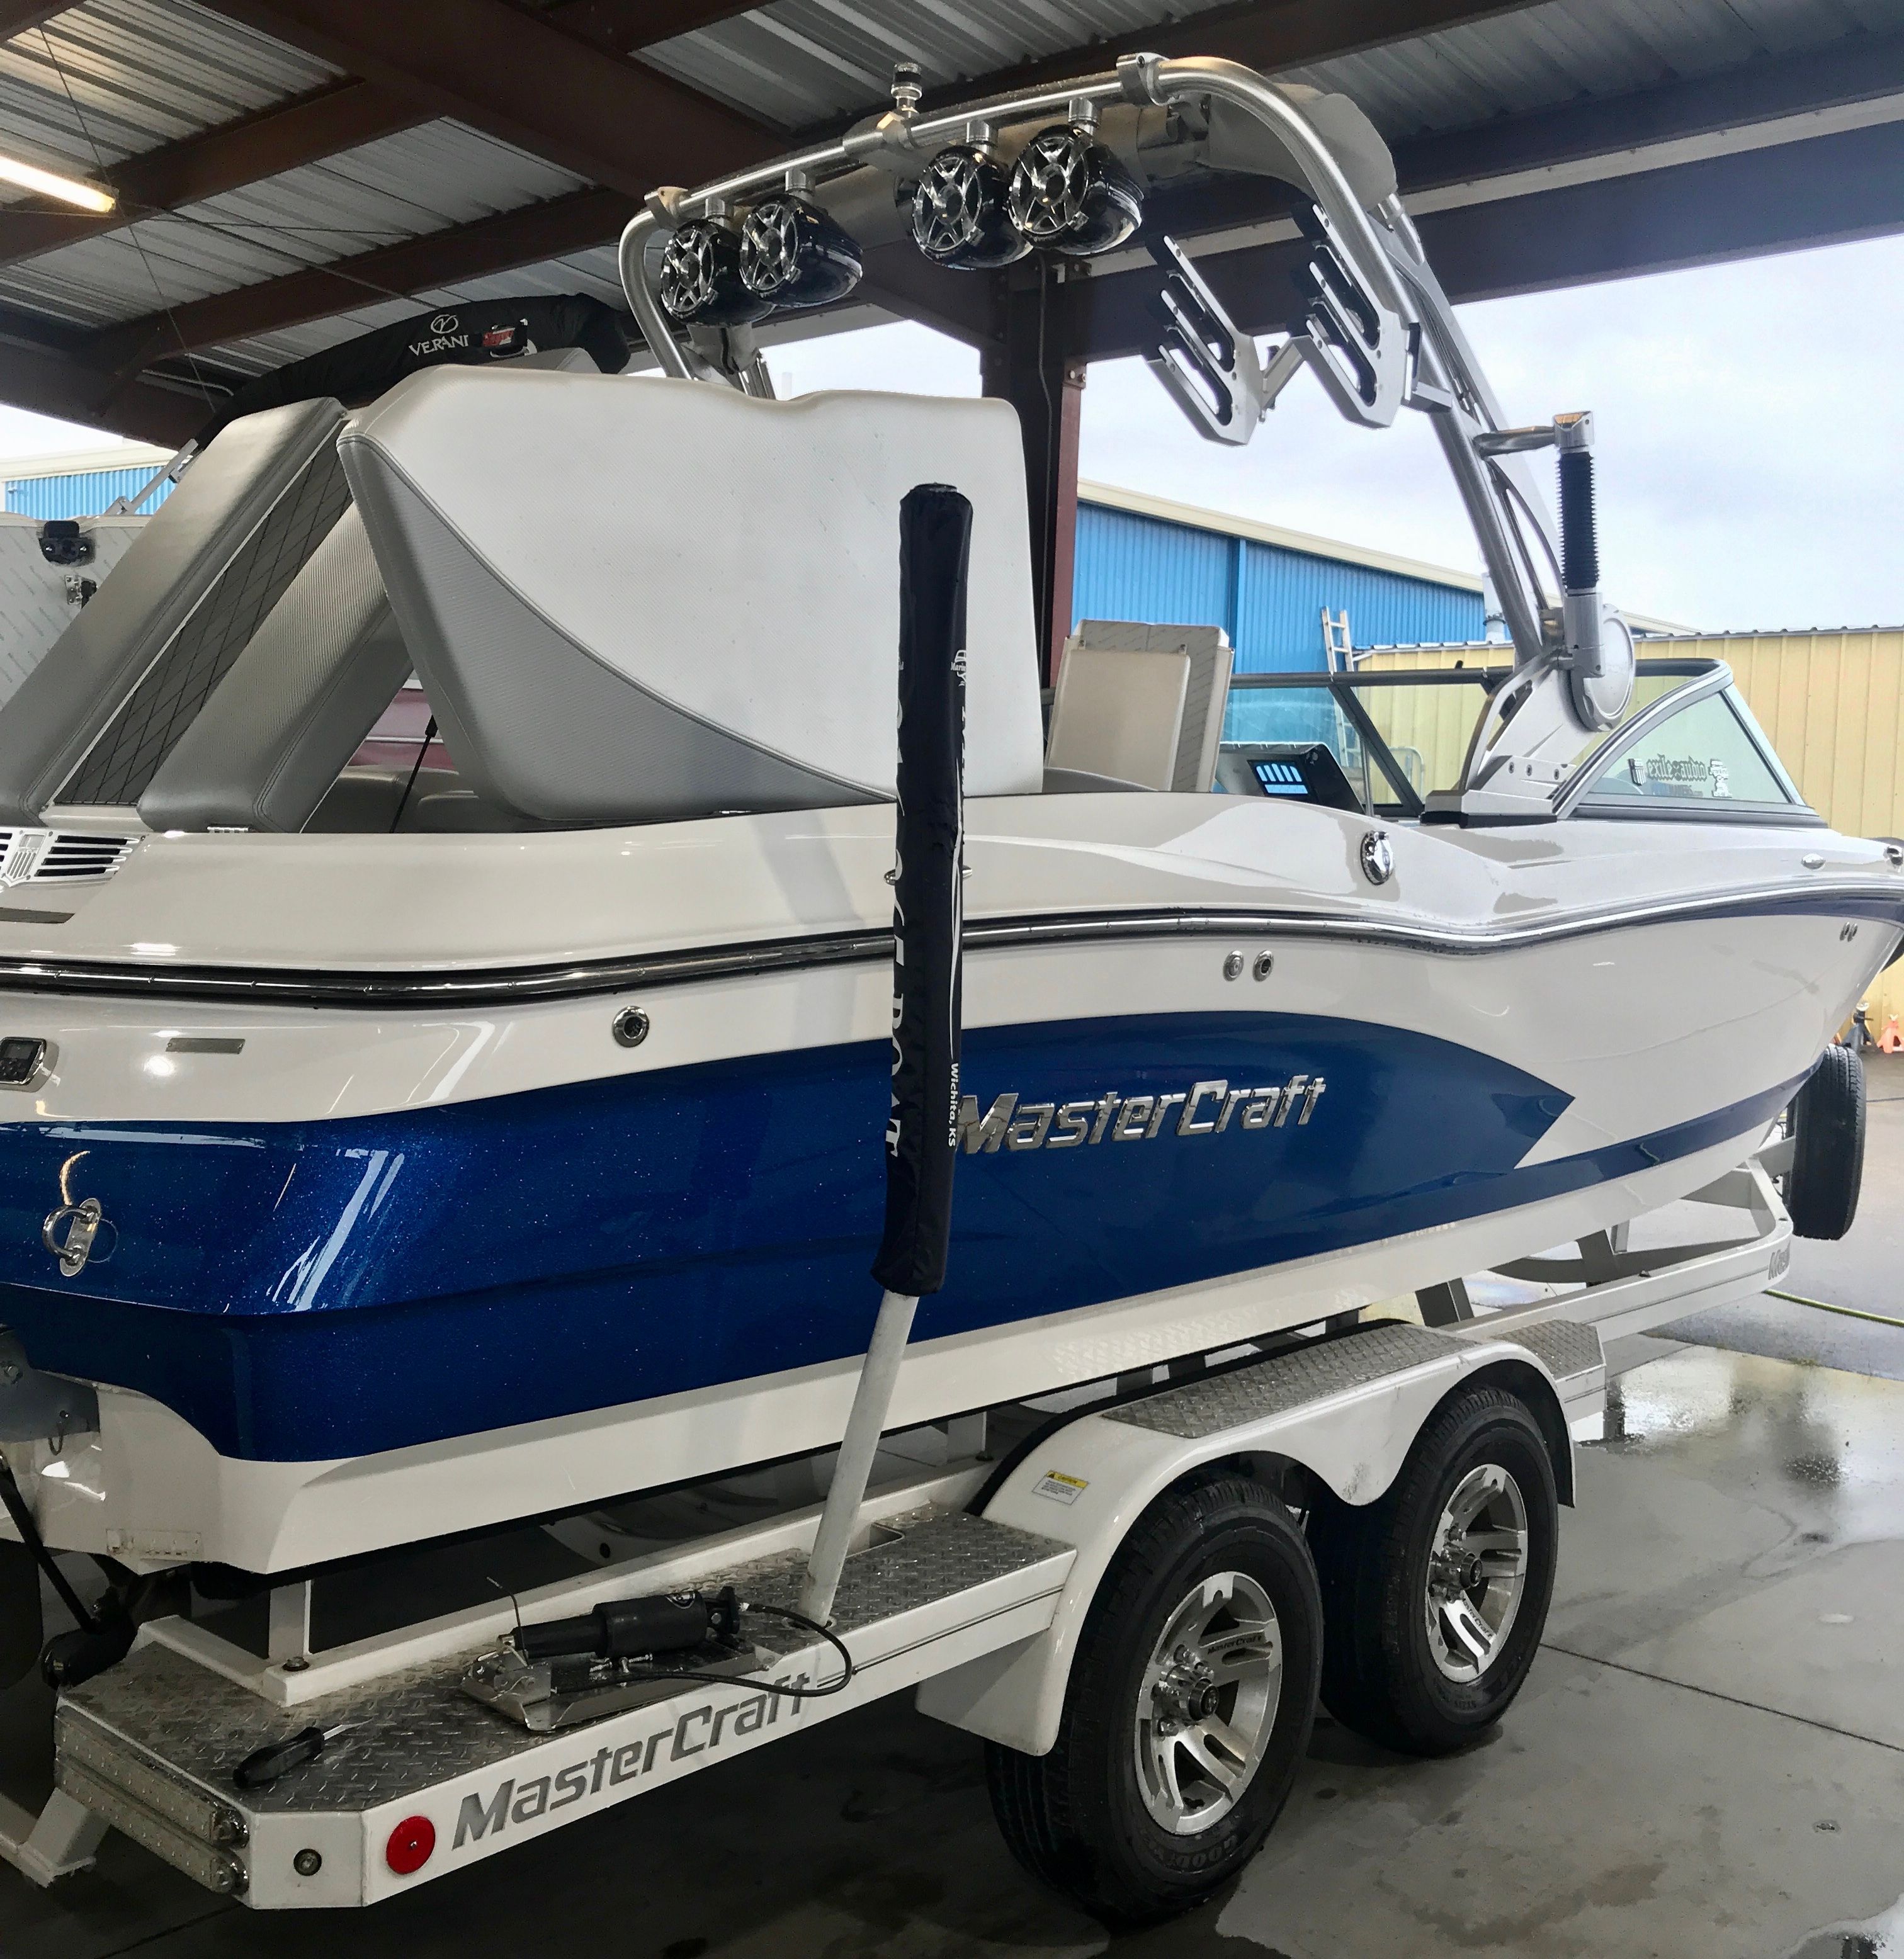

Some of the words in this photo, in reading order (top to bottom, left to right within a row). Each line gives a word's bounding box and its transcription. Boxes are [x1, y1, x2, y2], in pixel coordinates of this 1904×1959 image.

[409, 334, 469, 356] VERANI
[948, 1063, 959, 1125] Wichita,
[956, 1074, 1327, 1155] MasterCraft
[948, 1127, 956, 1147] KS
[451, 1671, 810, 1852] MasterCraft
